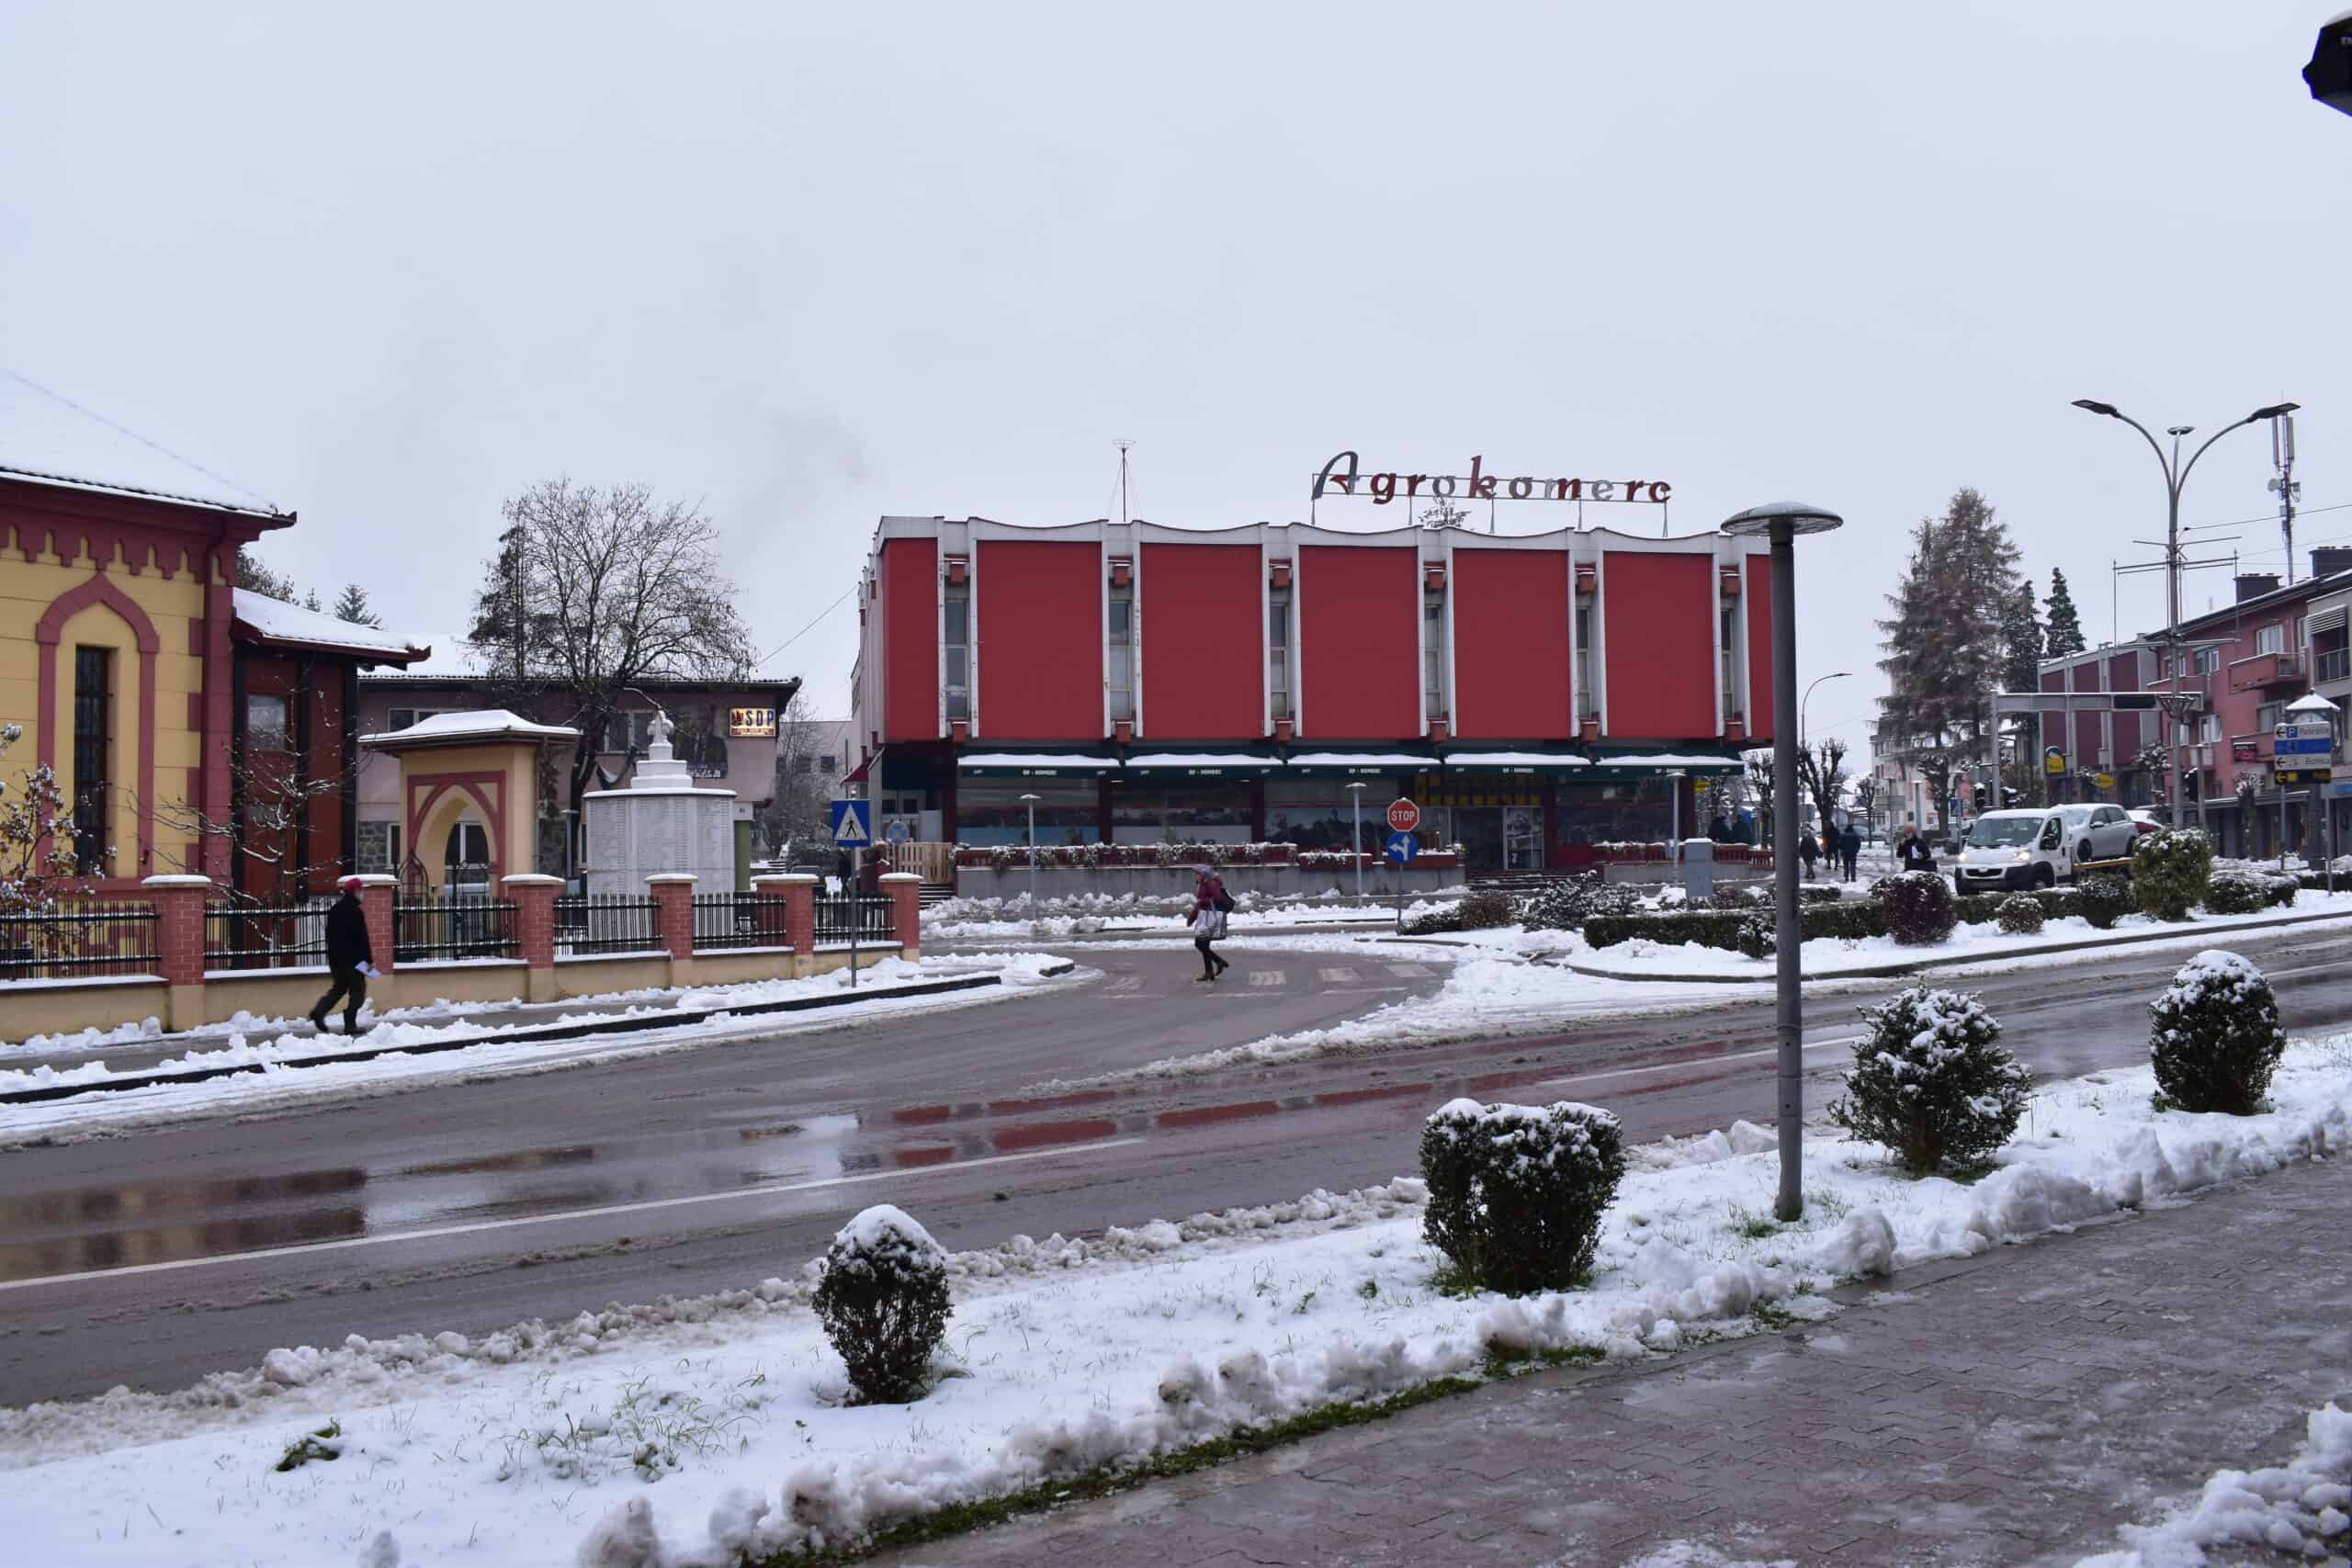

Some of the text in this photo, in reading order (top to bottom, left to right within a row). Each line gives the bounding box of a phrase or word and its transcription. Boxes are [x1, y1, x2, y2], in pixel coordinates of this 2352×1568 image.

[1311, 450, 1671, 504] Agrokomerc
[745, 710, 775, 727] SDP
[1391, 809, 1416, 822] STOP
